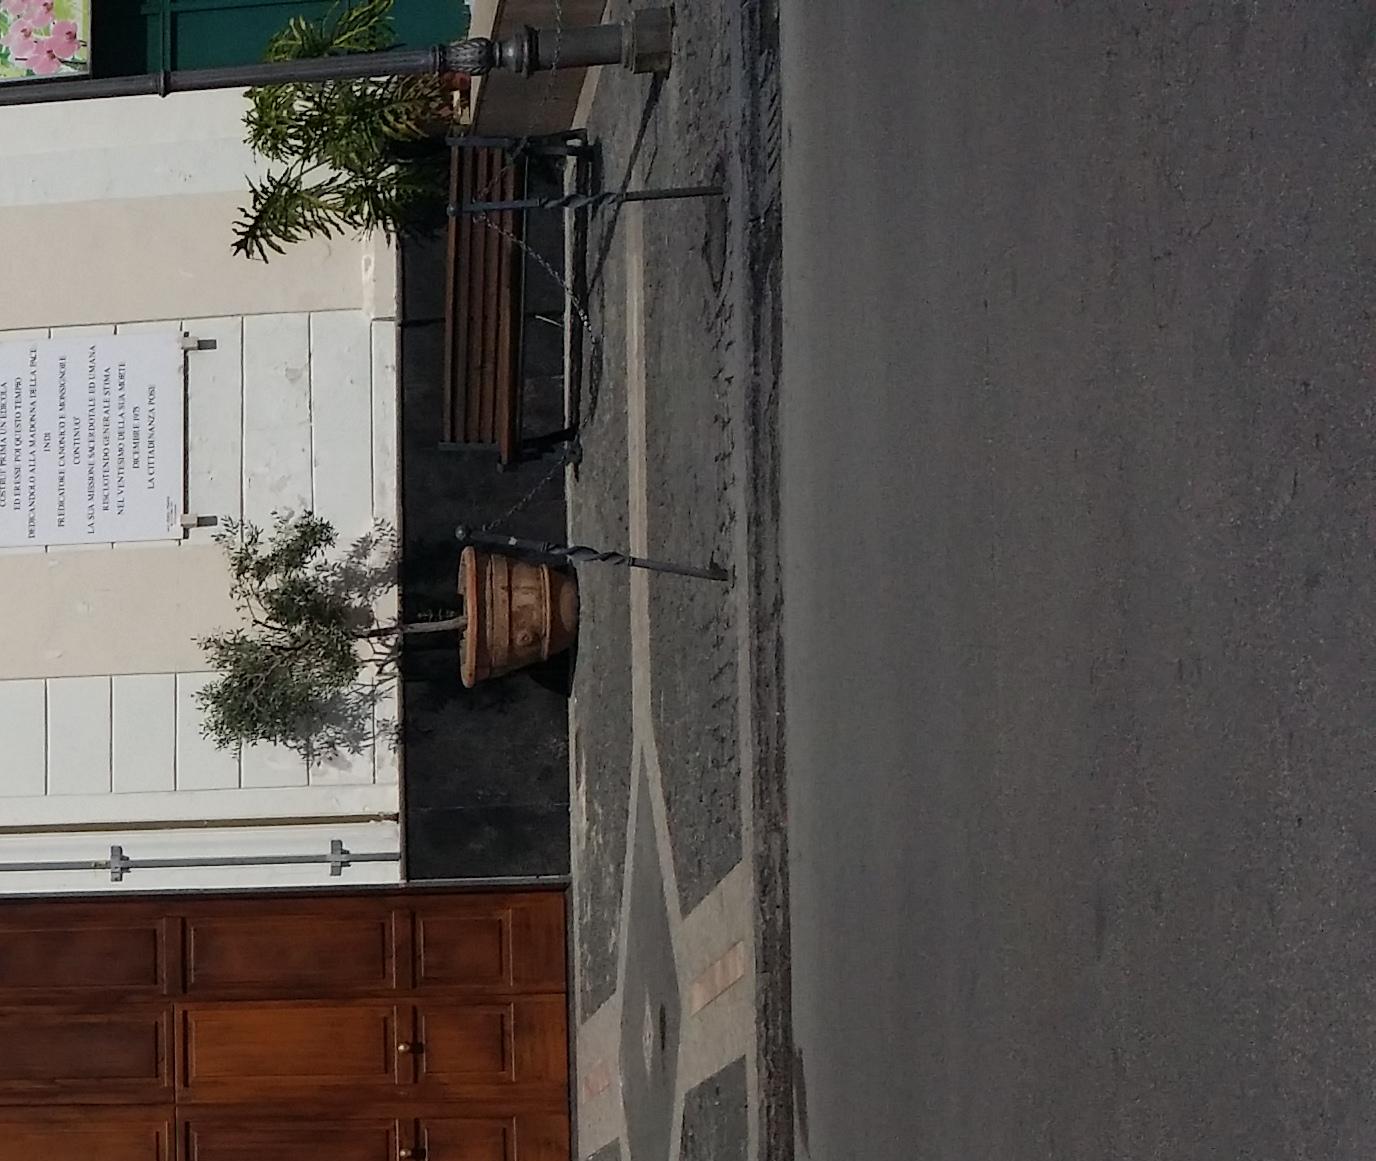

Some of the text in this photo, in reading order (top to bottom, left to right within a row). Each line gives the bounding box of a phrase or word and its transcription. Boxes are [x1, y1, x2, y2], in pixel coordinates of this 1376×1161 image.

[88, 345, 96, 380] UMANA
[0, 422, 6, 434] UN
[14, 412, 22, 446] QUESTO
[28, 450, 36, 472] ALLA
[148, 478, 155, 489] LA
[88, 522, 94, 534] LA
